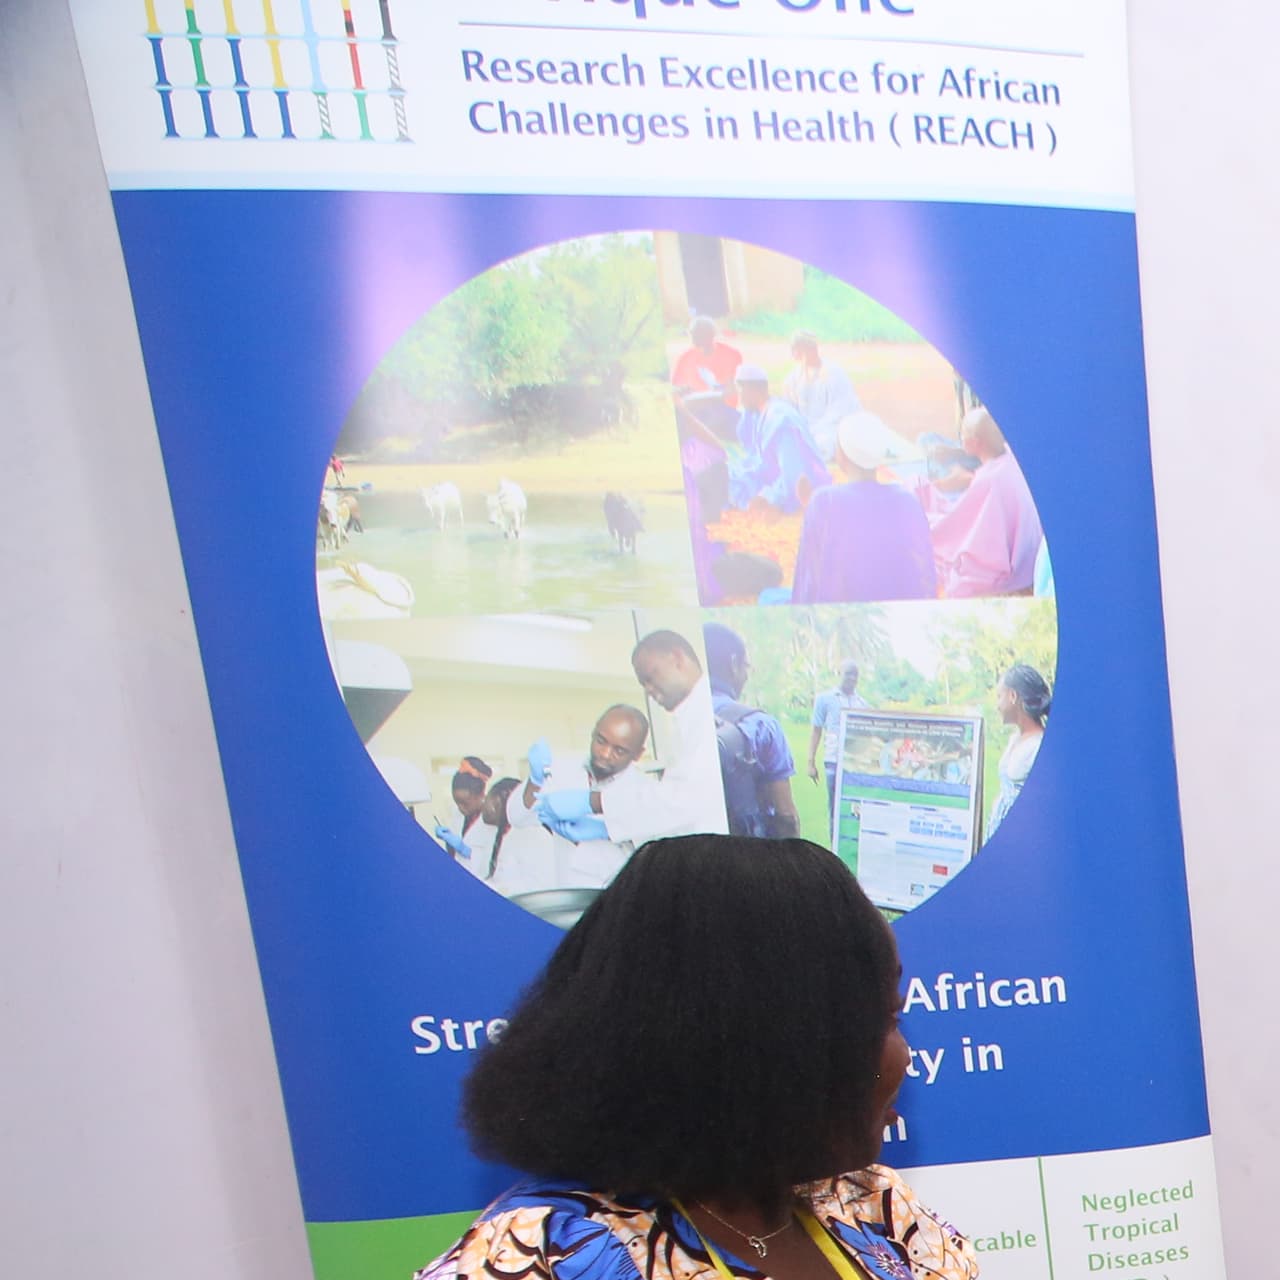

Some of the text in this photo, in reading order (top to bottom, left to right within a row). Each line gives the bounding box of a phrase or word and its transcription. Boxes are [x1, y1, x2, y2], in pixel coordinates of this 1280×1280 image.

[461, 48, 1062, 107] Research Excellence for African
[468, 100, 690, 146] Challenges
[705, 107, 739, 141] in
[753, 109, 875, 145] Health
[913, 113, 1035, 152] REACH
[902, 972, 1067, 1014] African
[962, 1037, 1004, 1072] in
[1081, 1180, 1194, 1213] Neglected
[1084, 1213, 1180, 1246] Tropical
[1087, 1244, 1190, 1272] Diseases
